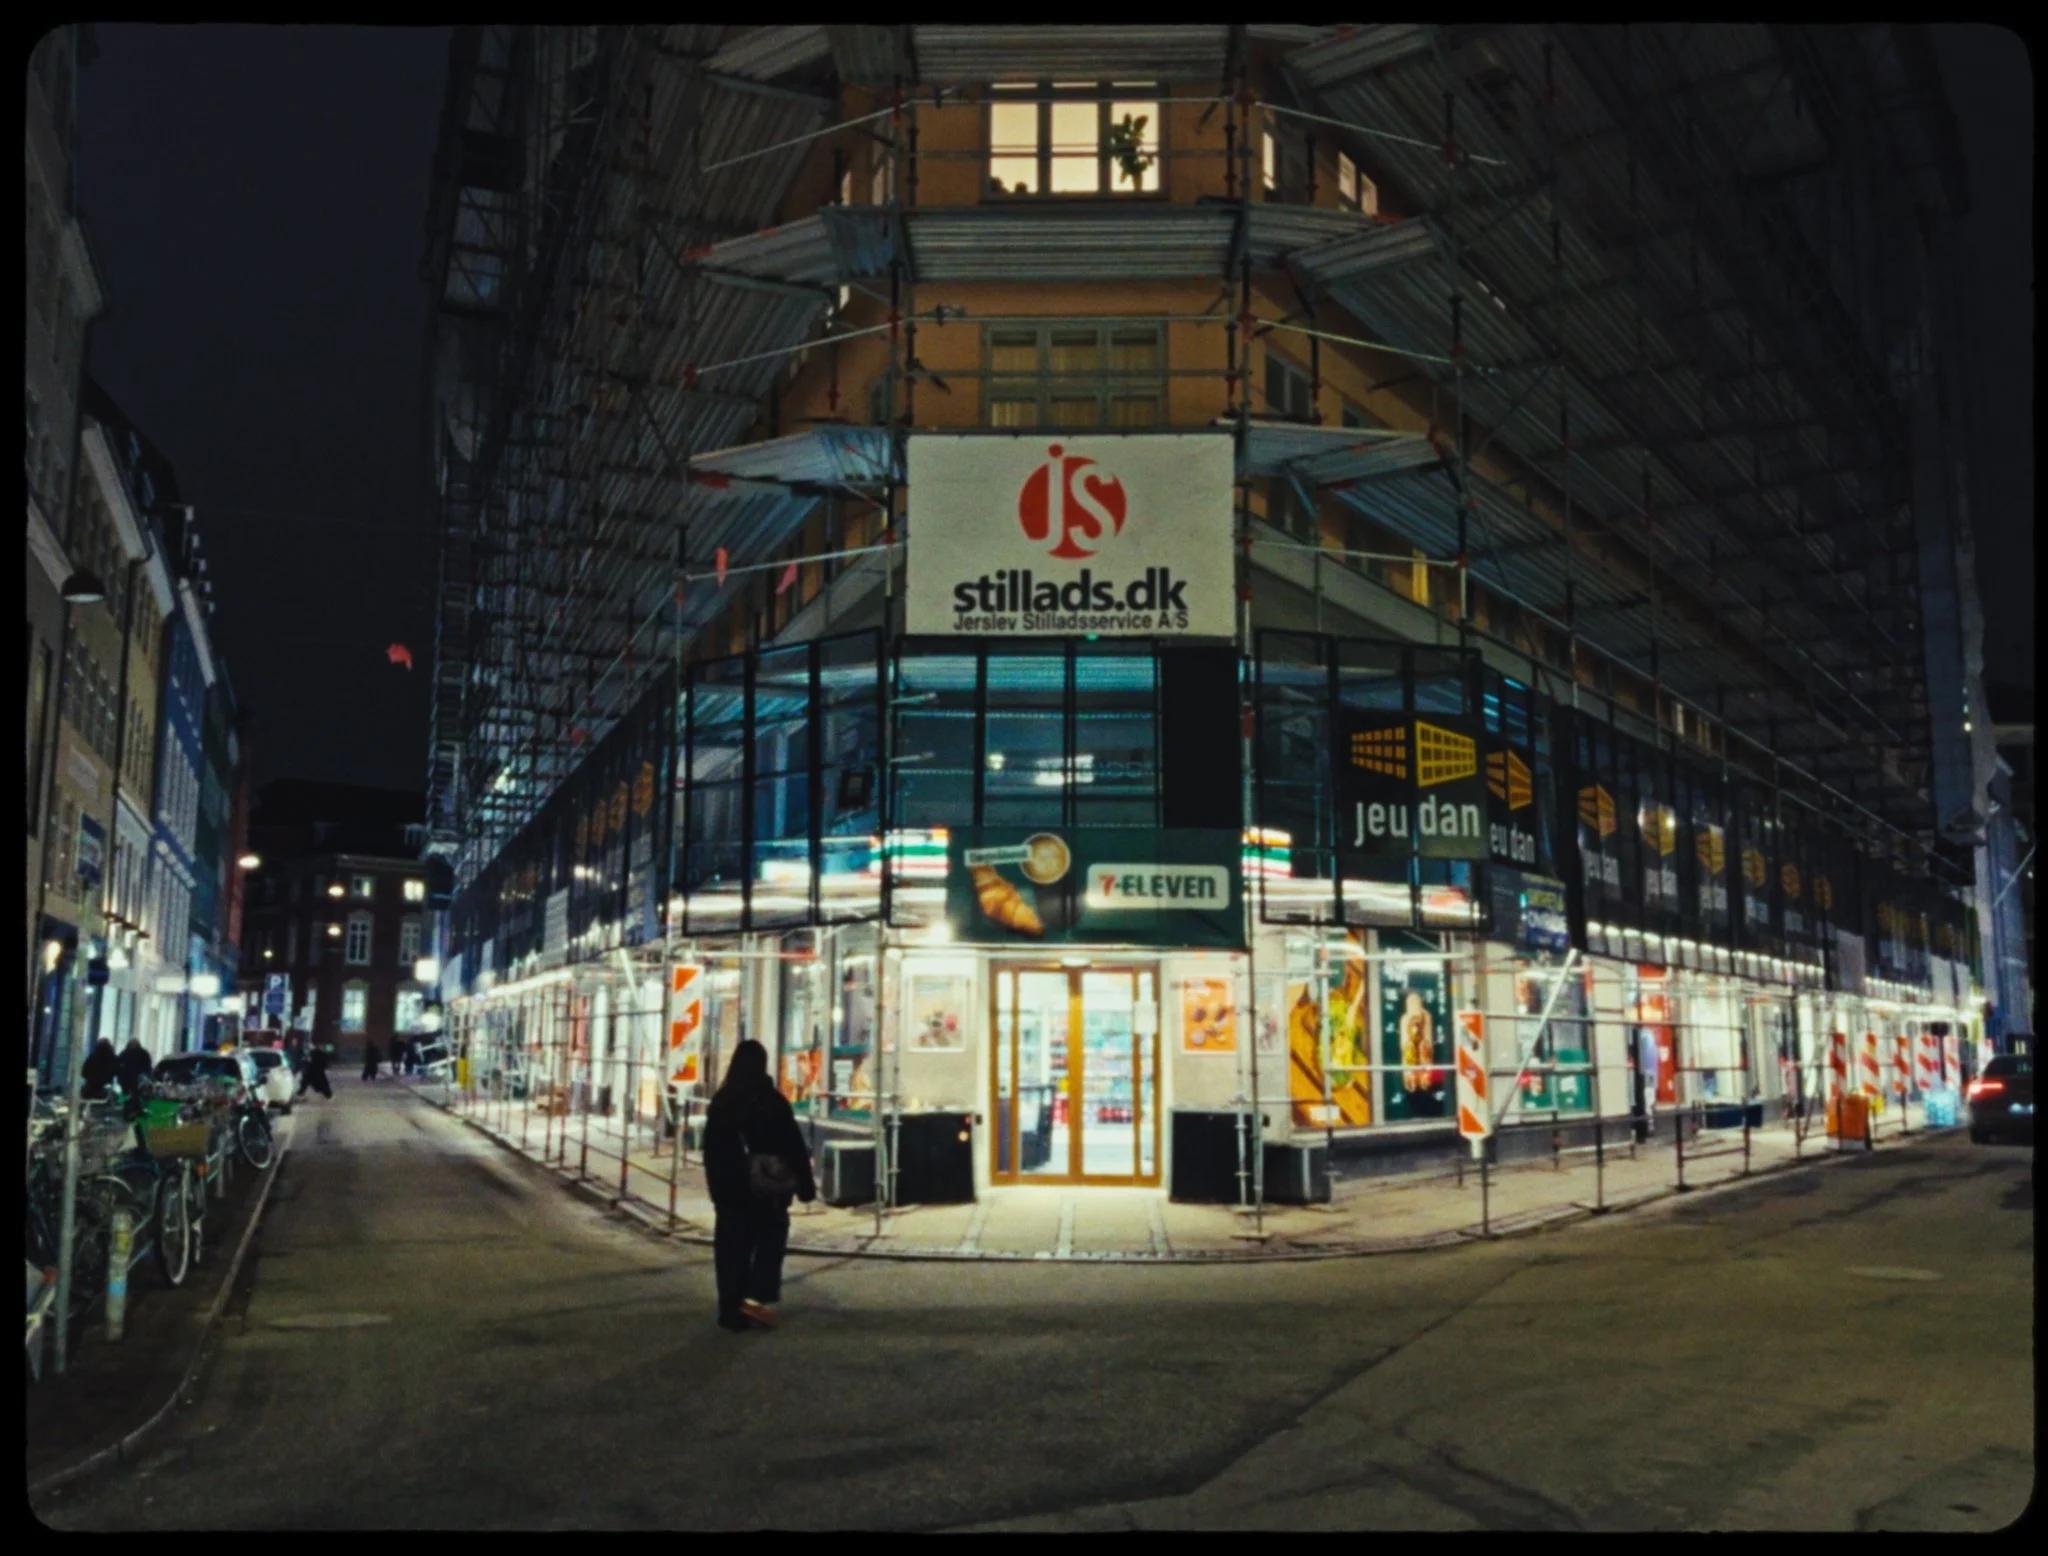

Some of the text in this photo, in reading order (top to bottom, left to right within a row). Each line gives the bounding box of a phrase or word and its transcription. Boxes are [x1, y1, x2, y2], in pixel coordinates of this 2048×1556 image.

[953, 567, 1189, 611] stillads.dk
[953, 612, 1017, 631] Jerslev
[1022, 611, 1153, 630] Stilladsservice
